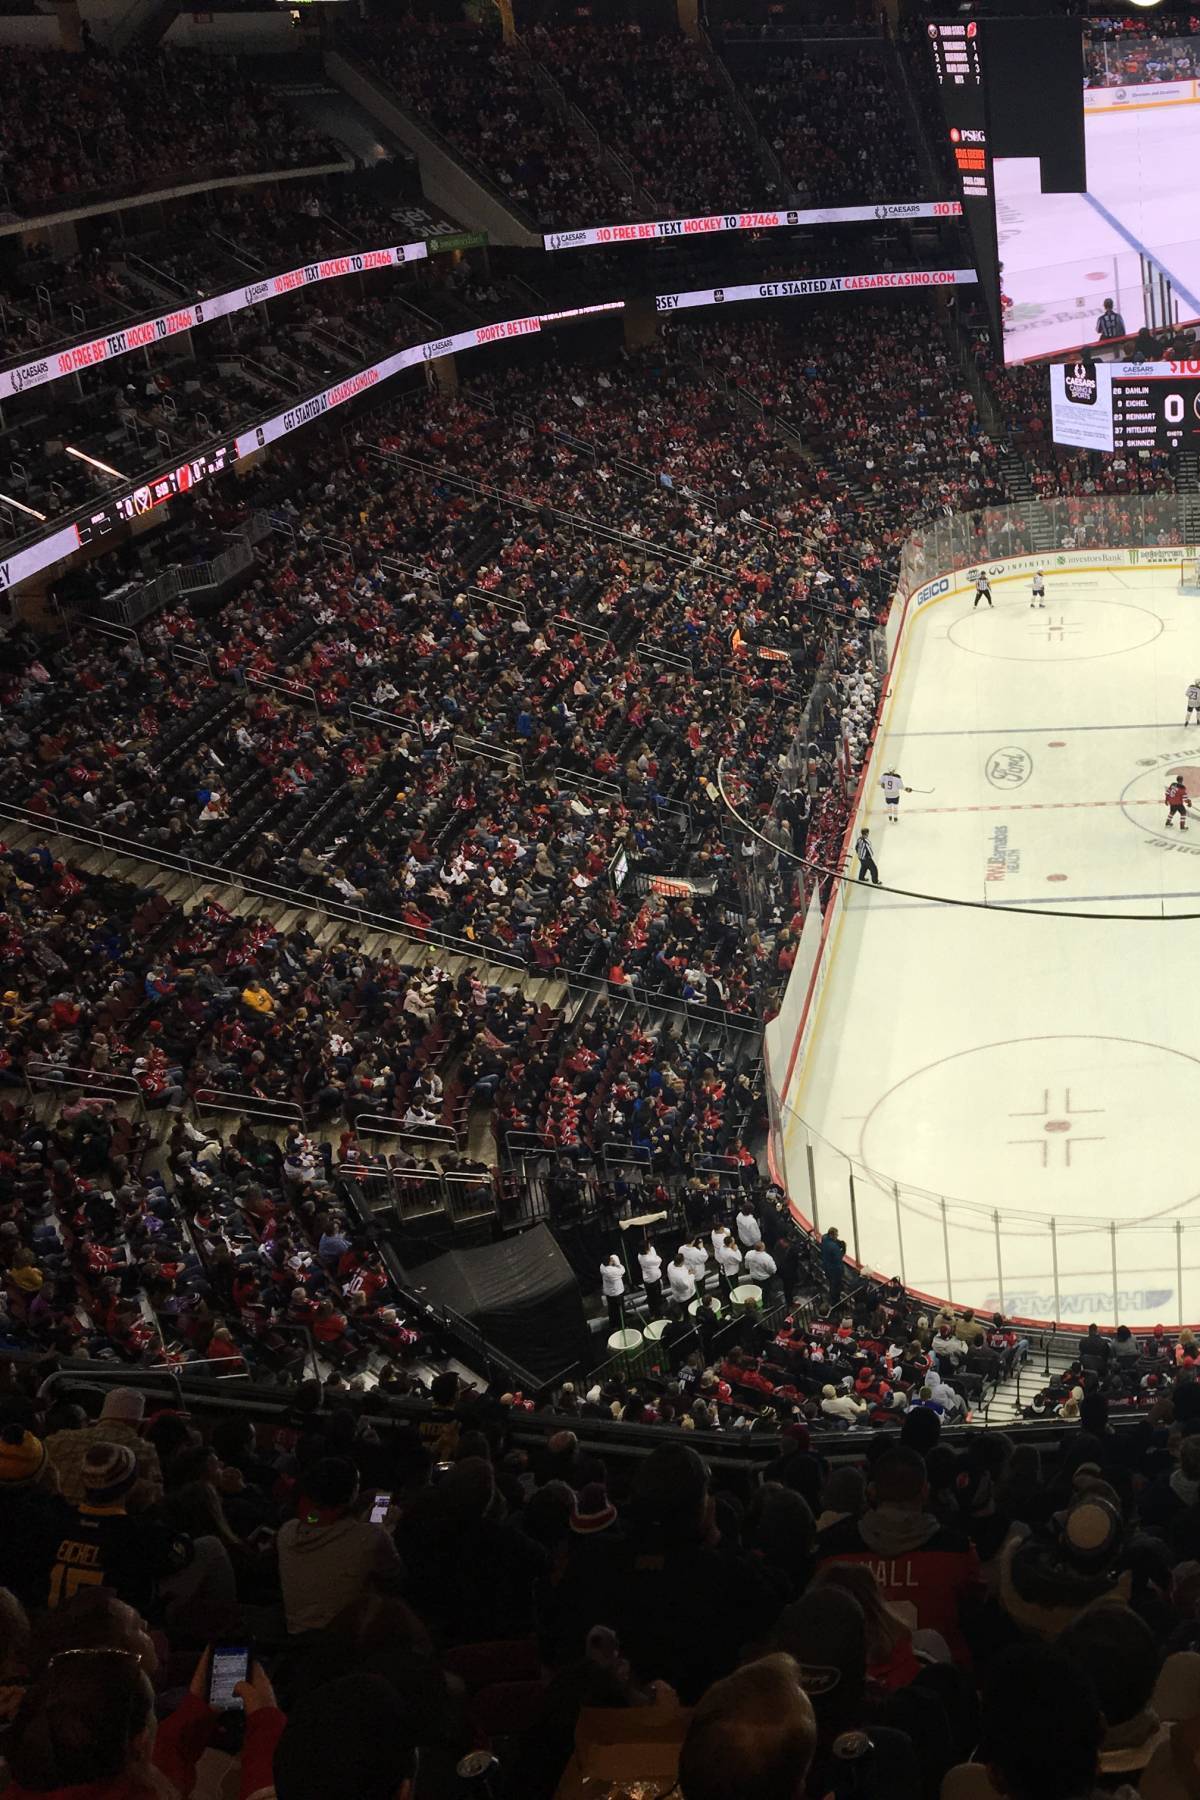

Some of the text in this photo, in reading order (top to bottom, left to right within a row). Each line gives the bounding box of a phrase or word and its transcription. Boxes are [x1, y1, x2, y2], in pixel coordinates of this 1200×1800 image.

[888, 205, 920, 213] CAESARS
[933, 203, 949, 214] $10
[560, 232, 586, 242] CAESARS
[596, 214, 778, 240] $10 FREE BET TEXT HOCKEY TO 227466
[304, 265, 319, 281] TEXT
[320, 258, 350, 277] HOCKEY
[350, 257, 362, 270] TO
[362, 251, 392, 268] 227466
[760, 272, 955, 296] GET STARTED AT CAESARSCASINO.COM
[72, 349, 92, 367] FREE
[93, 342, 108, 362] BET
[107, 333, 128, 355] TEXT
[126, 324, 156, 348] HOCKEY
[156, 319, 167, 336] TO
[167, 311, 193, 333] 227466
[476, 321, 505, 343] SPORTS
[21, 362, 49, 380] CAESARS
[1170, 360, 1200, 374] $10
[1066, 376, 1096, 388] CAESARS
[284, 412, 296, 431] GET
[295, 399, 320, 425] STARTED
[320, 394, 327, 412] AT
[1125, 413, 1156, 421] REINHART
[1164, 393, 1185, 423] 0
[1126, 439, 1155, 447] SKINNER
[917, 578, 949, 605] GEICO
[1190, 690, 1198, 700] 23
[990, 753, 1025, 782] Ford
[887, 780, 893, 790] 9
[56, 1539, 102, 1567] EICHEL
